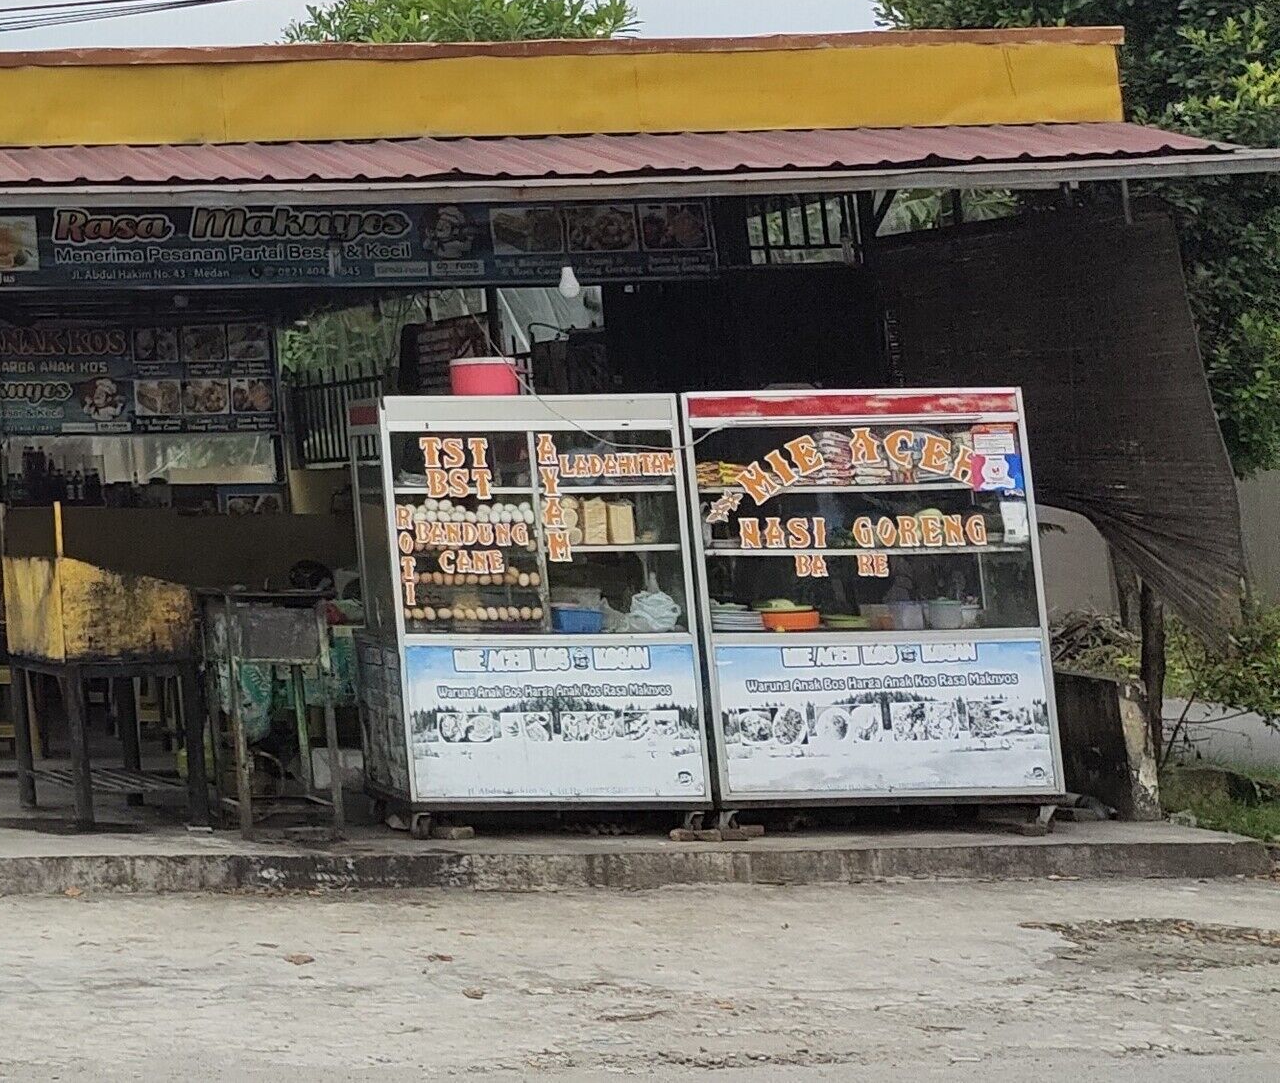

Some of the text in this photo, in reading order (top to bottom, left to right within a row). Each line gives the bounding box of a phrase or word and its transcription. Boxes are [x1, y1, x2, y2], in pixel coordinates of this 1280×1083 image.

[52, 206, 412, 246] Rasa Maknyos
[55, 247, 144, 264] Menerima
[146, 246, 226, 263] Pesanan
[346, 244, 361, 259] &
[365, 242, 411, 258] Kecil
[85, 269, 116, 280] Abdul
[121, 268, 152, 279] Hakim
[194, 268, 230, 278] Medan
[68, 329, 127, 355] KOS
[40, 361, 76, 373] ANAK
[81, 361, 109, 372] KOS
[419, 437, 489, 468] TST
[739, 435, 824, 506] MIE
[426, 468, 492, 500] BST
[537, 434, 573, 562] AYAM
[415, 520, 529, 546] BANDUNG
[739, 515, 987, 549] NASI GORENG
[396, 505, 416, 606] ROTI
[438, 549, 505, 574] CANE
[437, 683, 672, 698] Warung Anak Bos Harga Anak Kos Rasa Maknyos
[746, 672, 1019, 693] Warung Anak Bos Harga Anak Kos Rasa Maknyos
